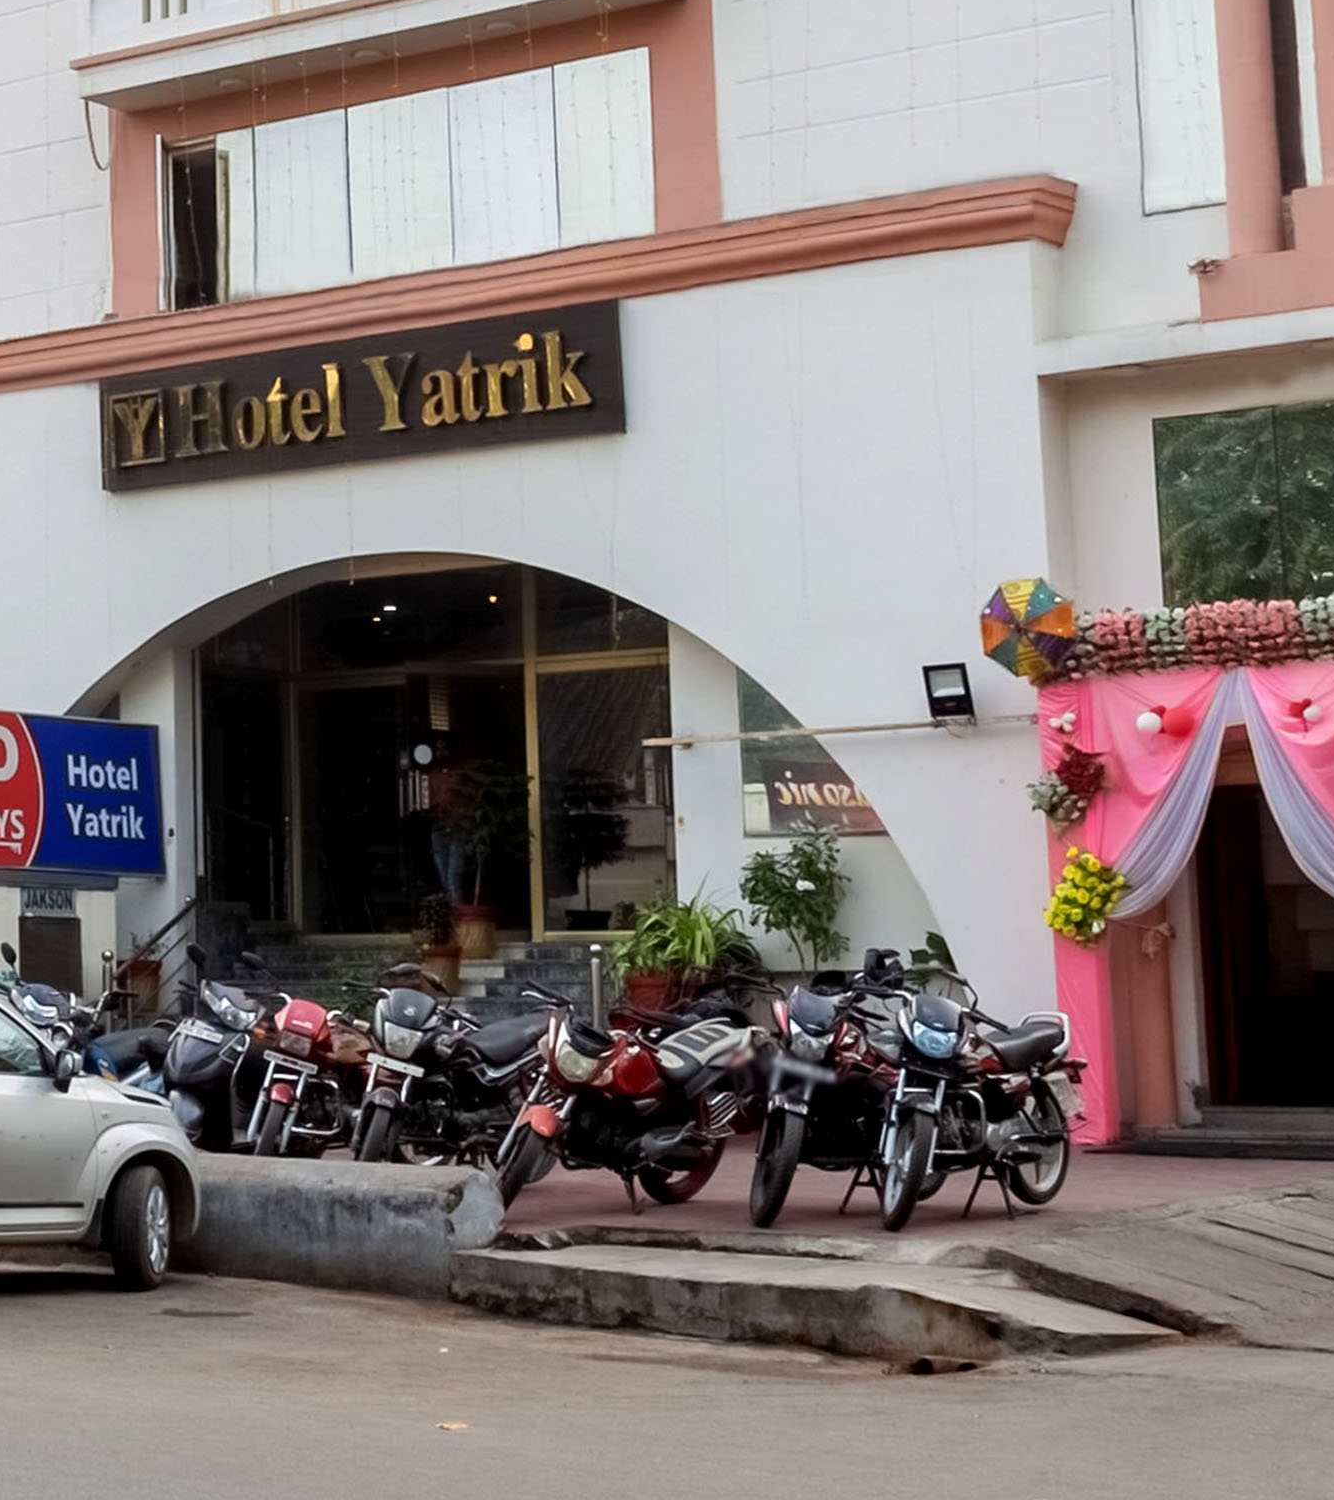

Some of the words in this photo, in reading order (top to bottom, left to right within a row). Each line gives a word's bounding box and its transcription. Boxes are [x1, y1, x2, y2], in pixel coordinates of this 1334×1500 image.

[175, 362, 346, 458] Hotel
[363, 331, 593, 431] Yatrik
[67, 754, 139, 792] Hotel
[66, 802, 146, 841] Yatrik
[24, 887, 73, 911] JAKSON
